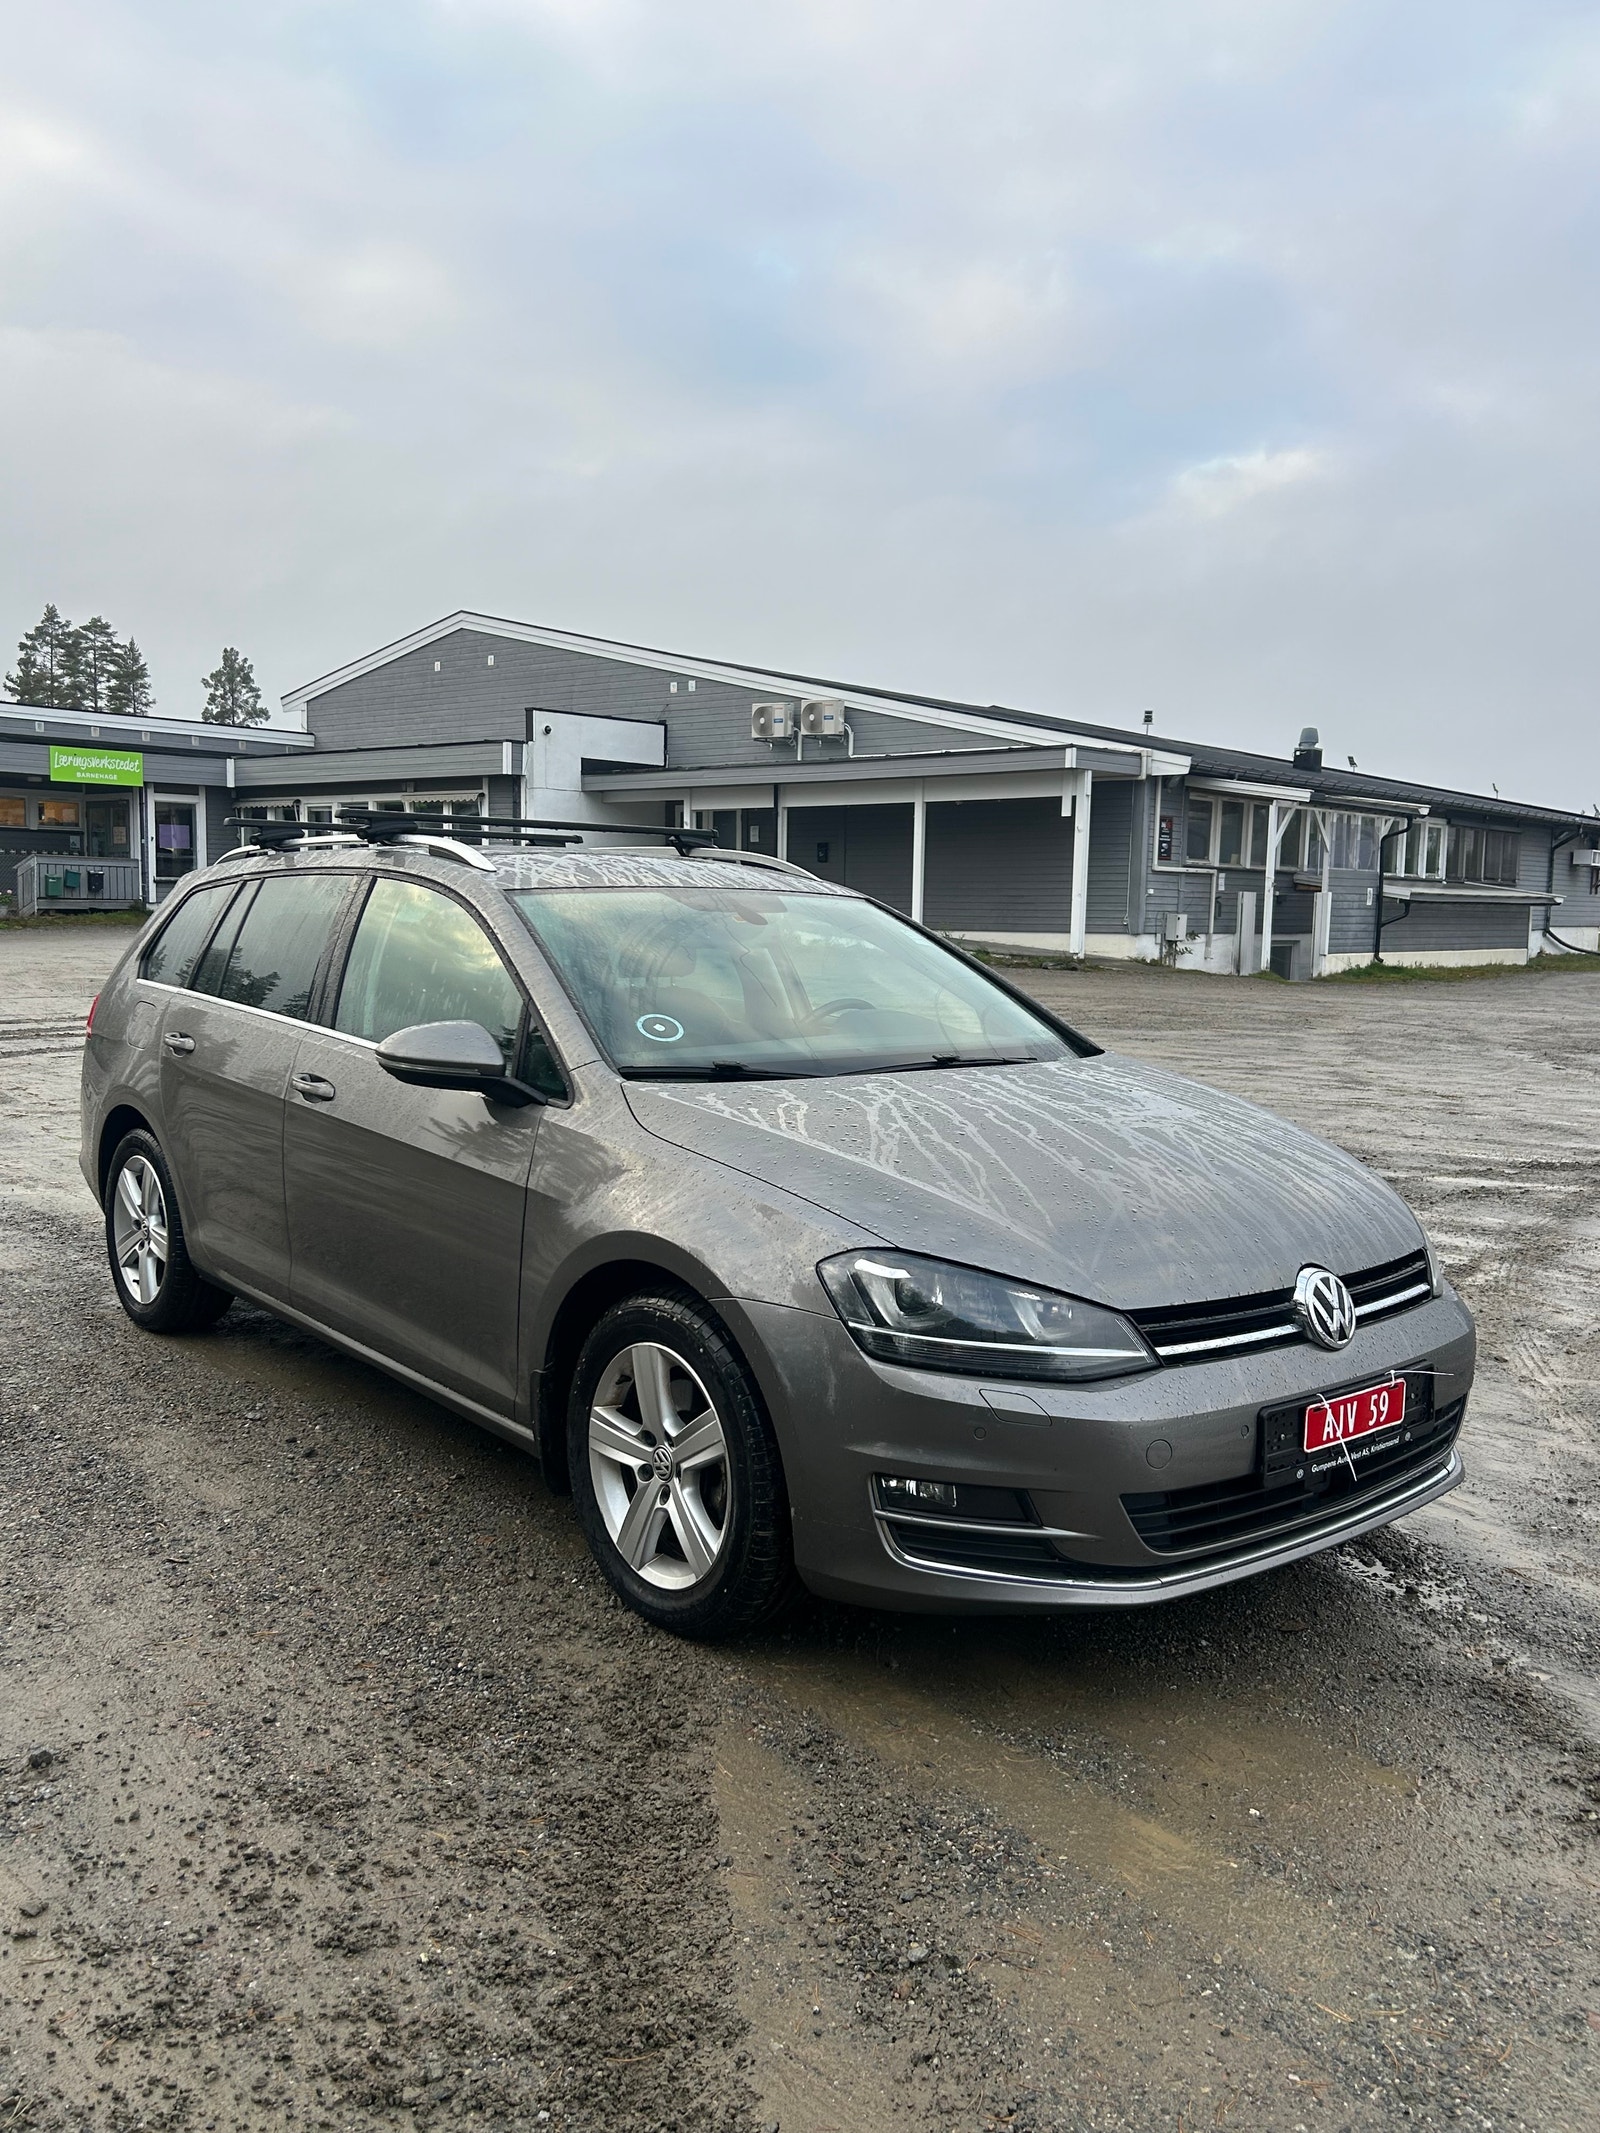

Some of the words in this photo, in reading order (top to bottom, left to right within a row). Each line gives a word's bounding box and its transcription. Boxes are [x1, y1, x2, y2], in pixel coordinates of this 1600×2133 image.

[76, 771, 118, 780] BARNEHAGE
[1368, 1390, 1389, 1427] 59
[1311, 1459, 1337, 1473] Gumpens
